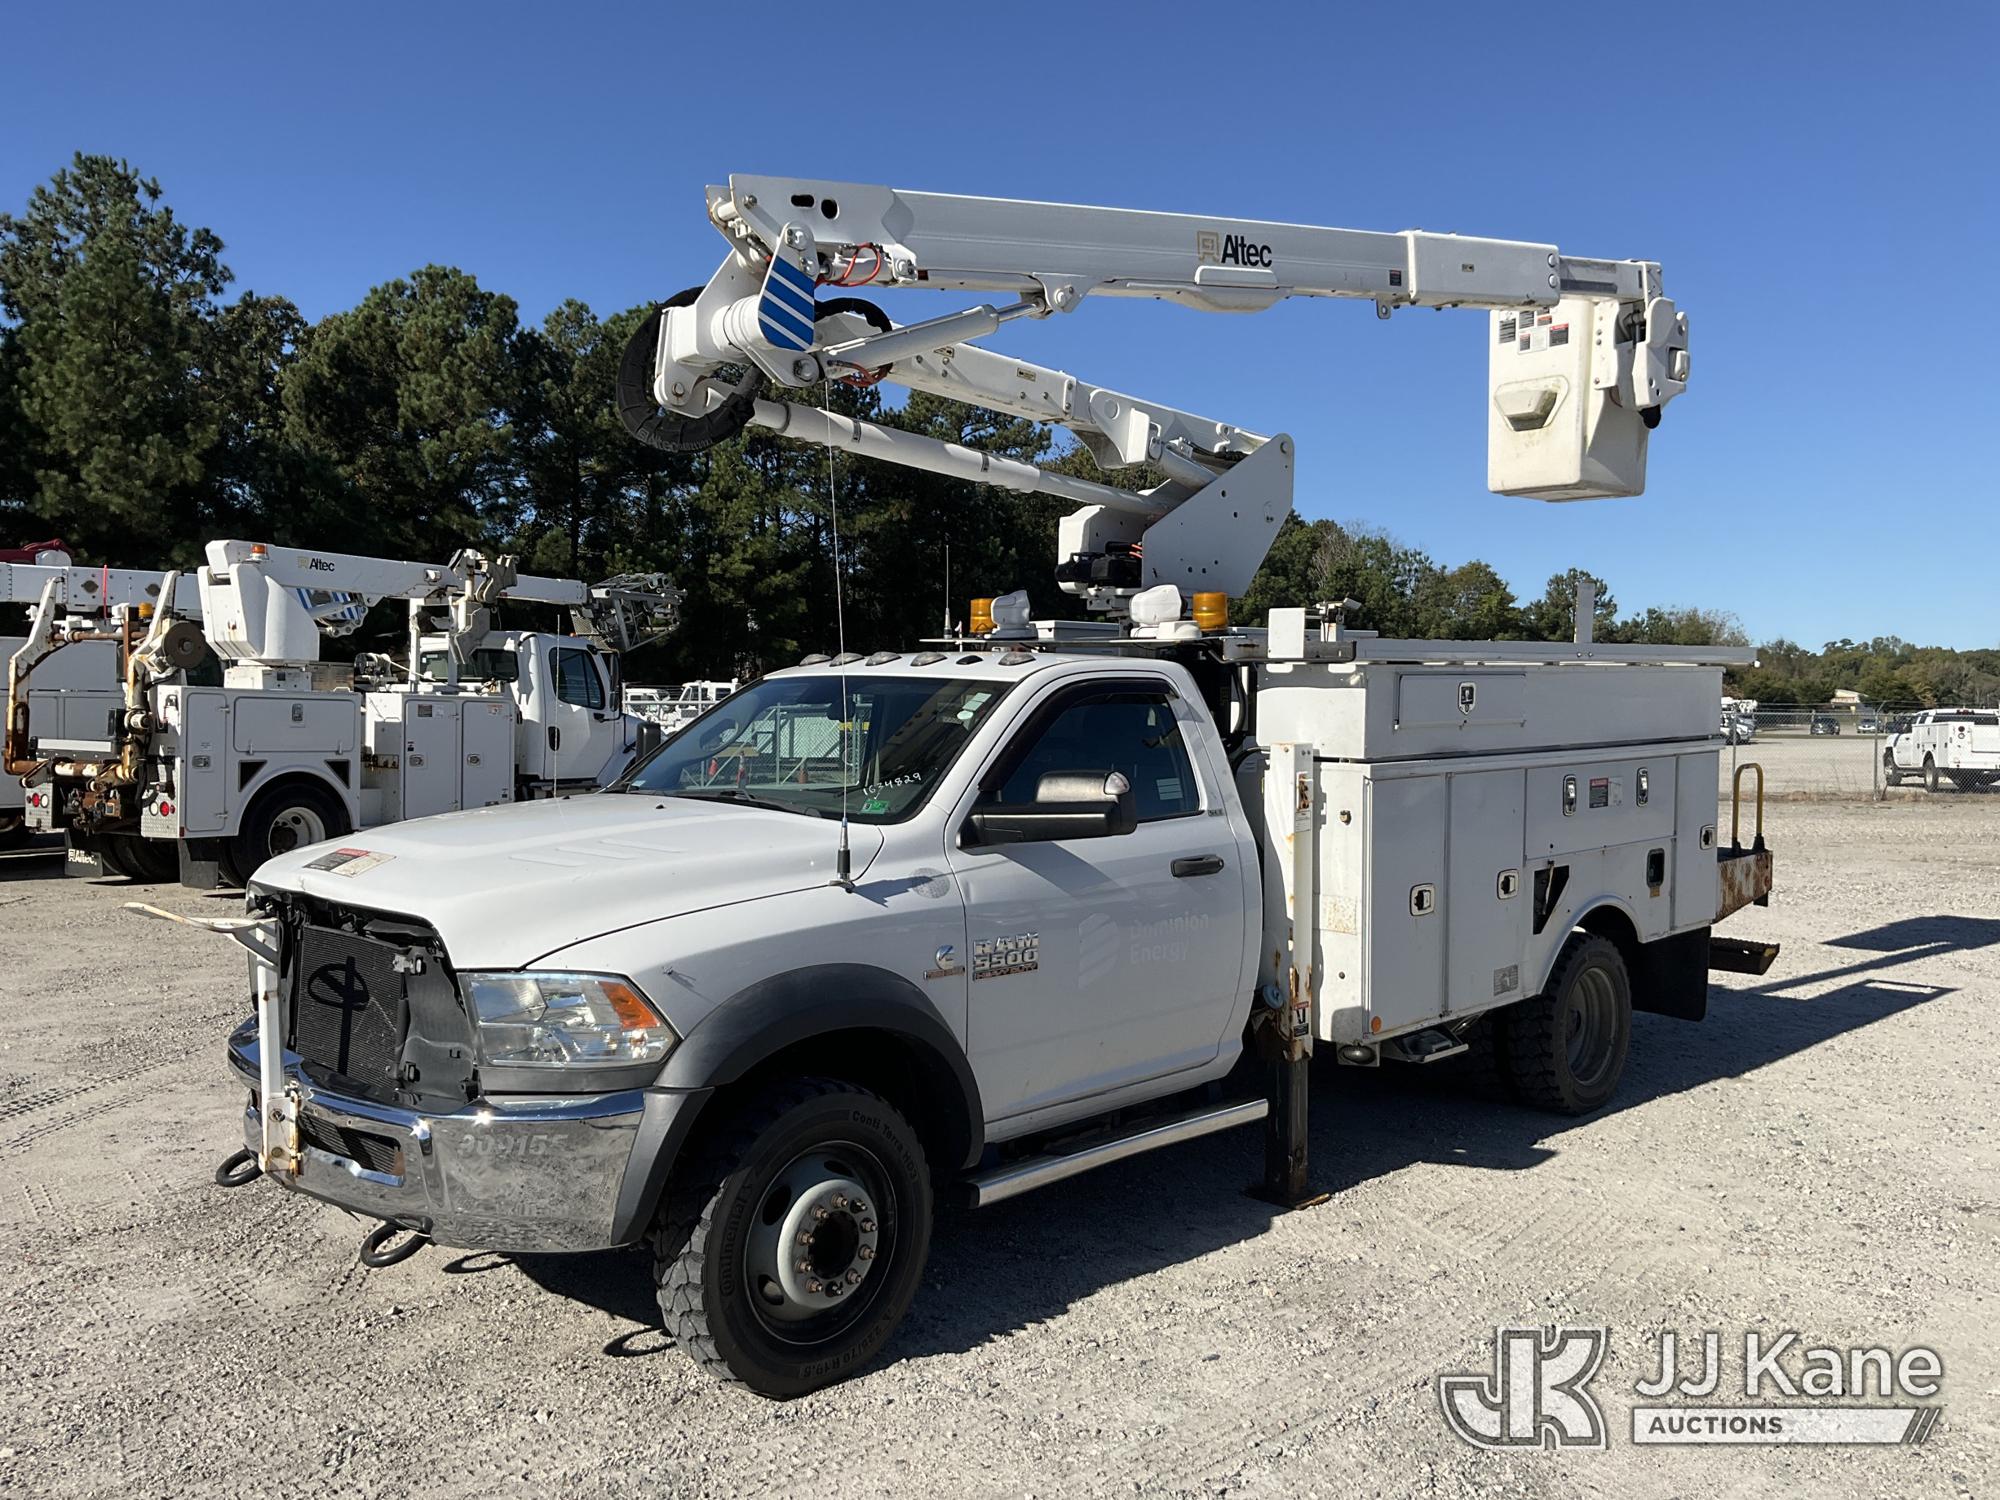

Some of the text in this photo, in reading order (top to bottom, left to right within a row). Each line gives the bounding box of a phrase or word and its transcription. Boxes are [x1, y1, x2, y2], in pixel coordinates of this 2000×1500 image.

[1221, 234, 1273, 268] Altec
[309, 557, 336, 572] Altec
[1130, 912, 1210, 939] Dominion
[973, 931, 1040, 955] RAM
[1130, 939, 1189, 965] Energy
[973, 947, 1039, 972] 5500
[852, 1110, 881, 1130] Conti
[719, 1196, 747, 1296] Continental
